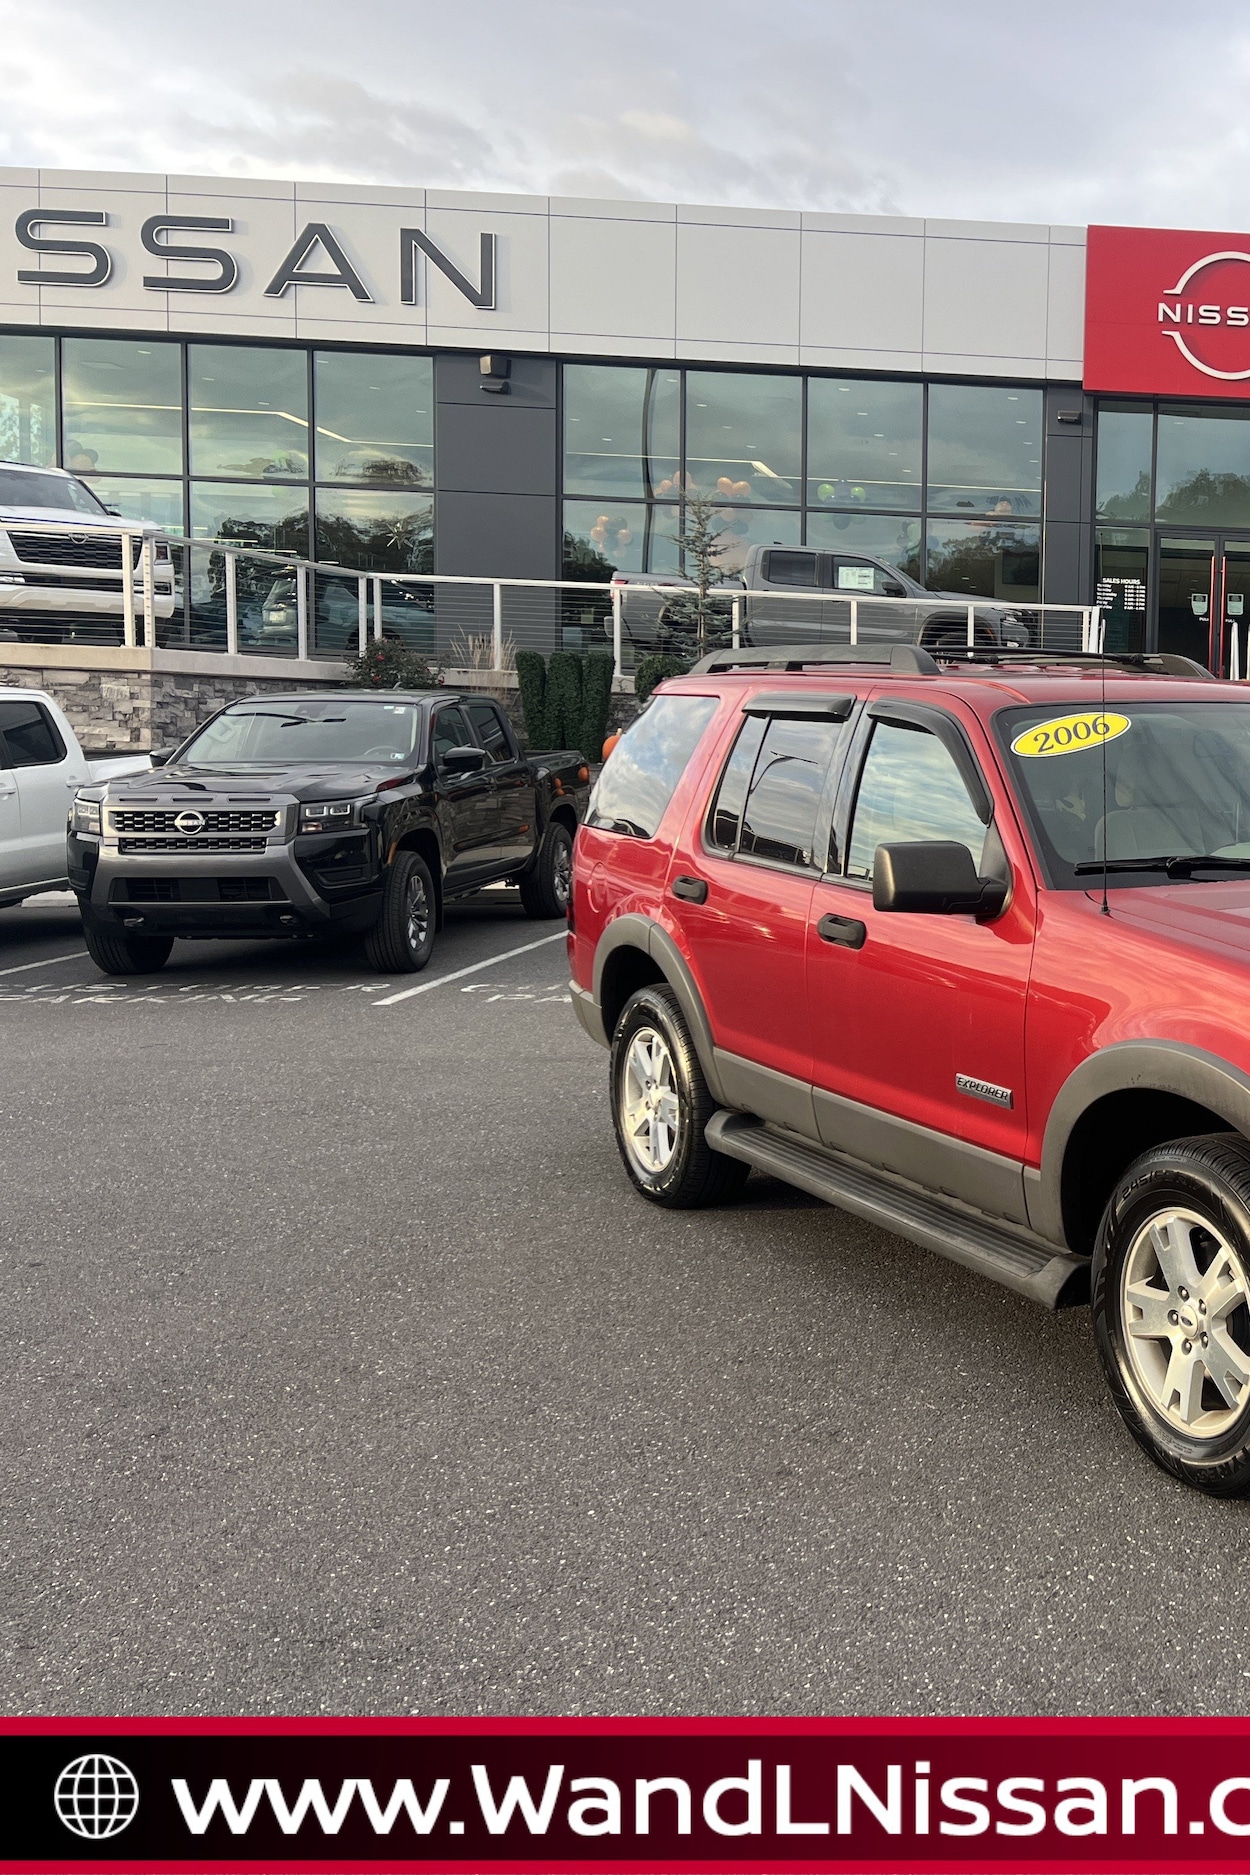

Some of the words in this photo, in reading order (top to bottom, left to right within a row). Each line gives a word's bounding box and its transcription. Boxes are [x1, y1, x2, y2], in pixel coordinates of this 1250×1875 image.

[14, 208, 498, 310] SSAN
[1033, 715, 1110, 753] 2006
[956, 1076, 1009, 1101] EXPLORER
